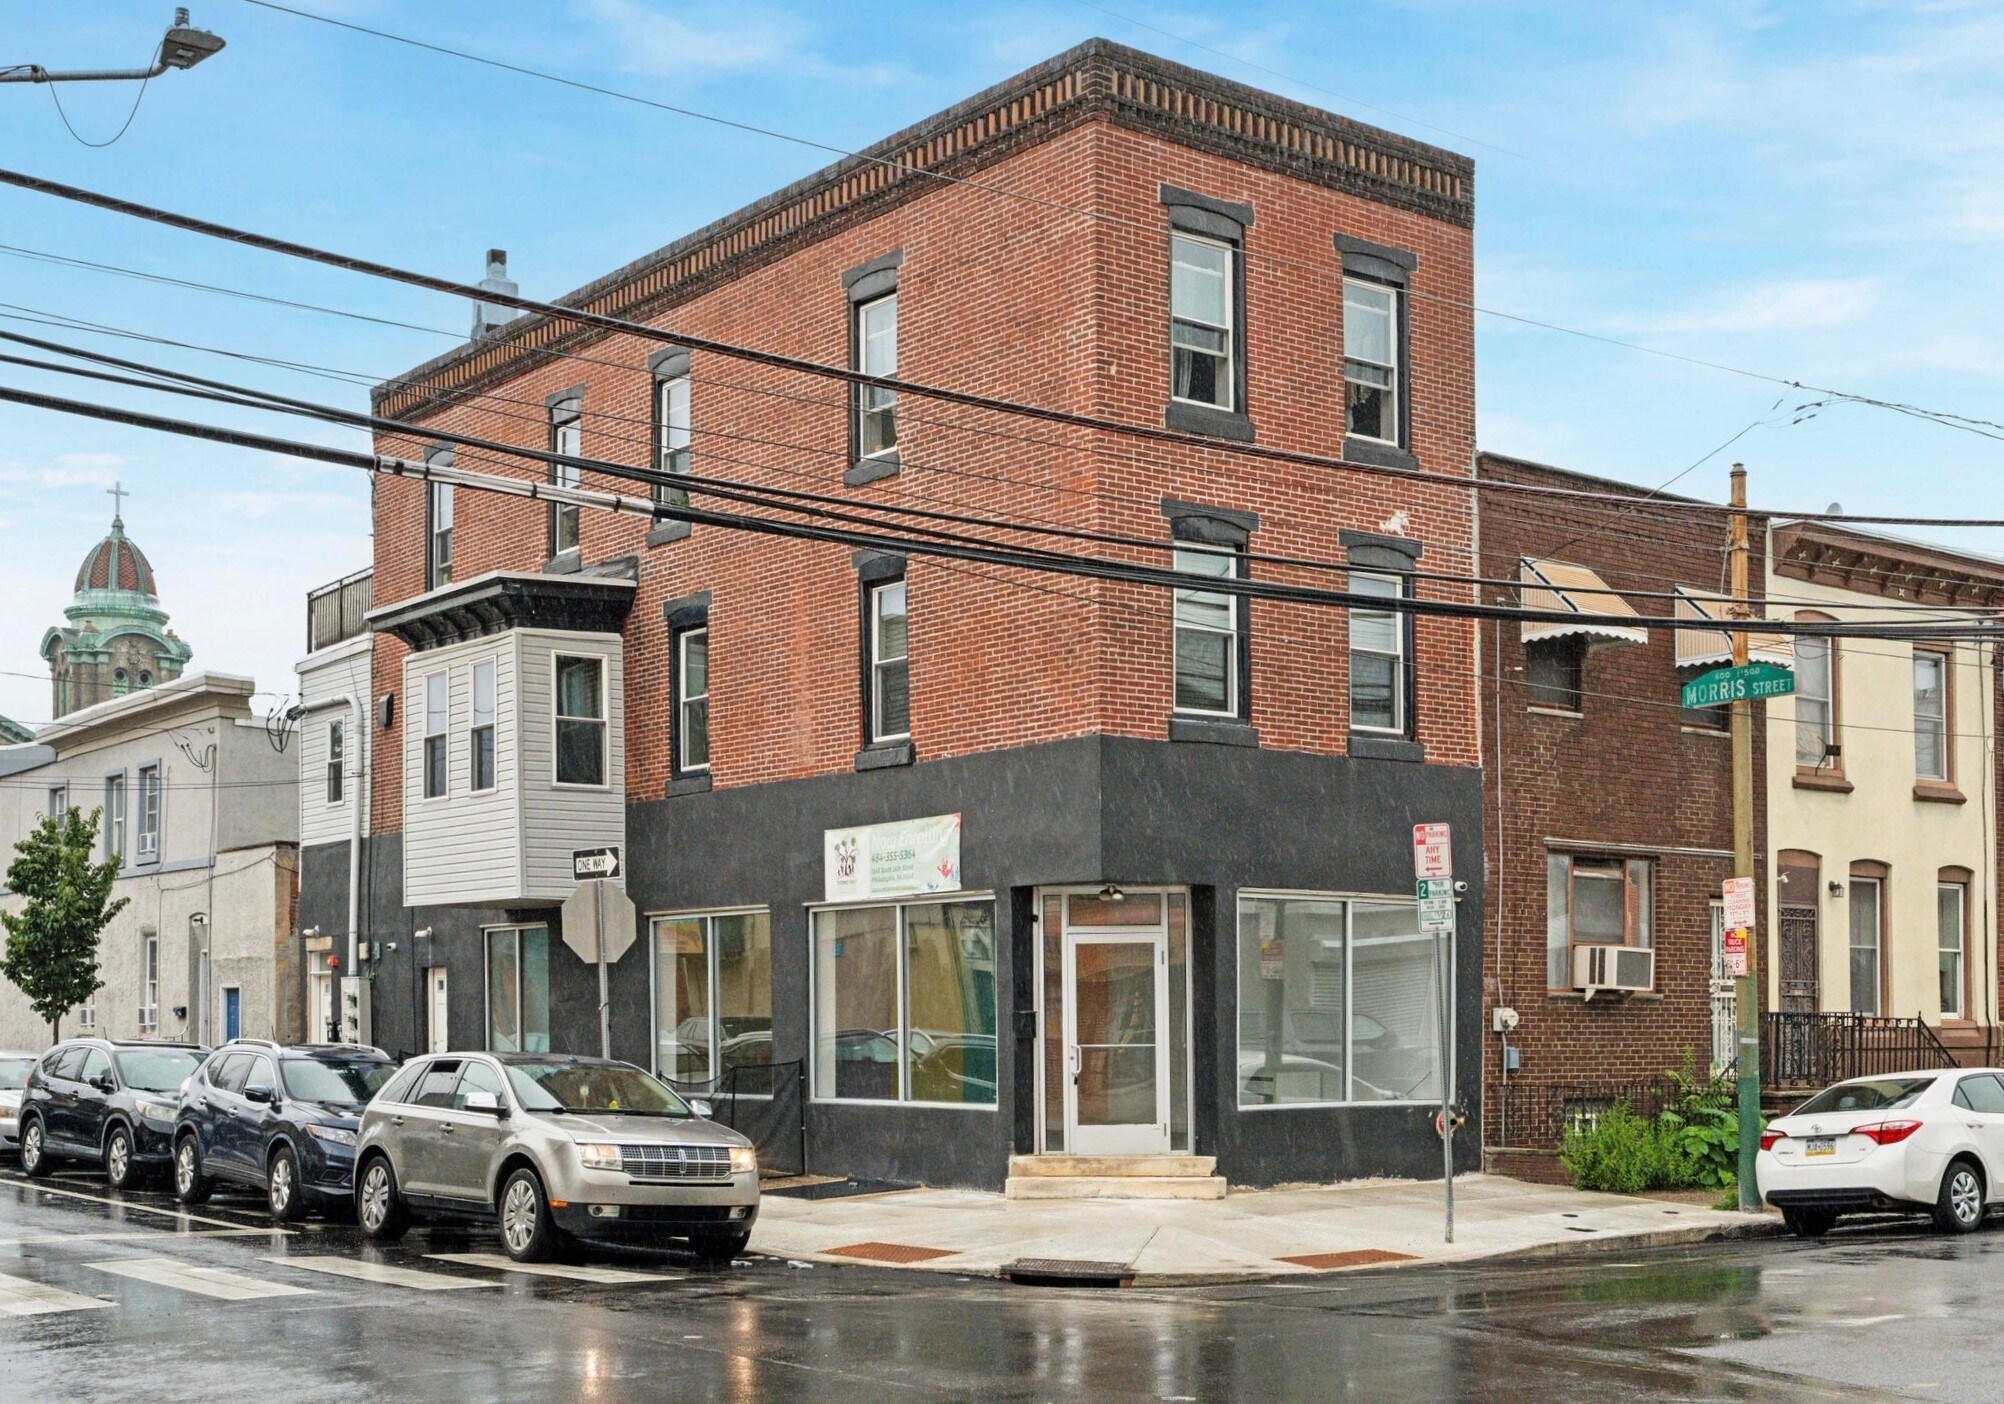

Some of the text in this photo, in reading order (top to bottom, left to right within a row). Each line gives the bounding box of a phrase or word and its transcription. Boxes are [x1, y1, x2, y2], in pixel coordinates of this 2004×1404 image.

[1686, 678, 1792, 705] MORRIS STREET
[1425, 829, 1448, 838] PARKING
[1425, 845, 1440, 855] ANY
[578, 857, 606, 872] ONE WAY
[1424, 855, 1442, 865] TIME
[1419, 882, 1427, 897] 2
[1727, 938, 1742, 946] TRUCK
